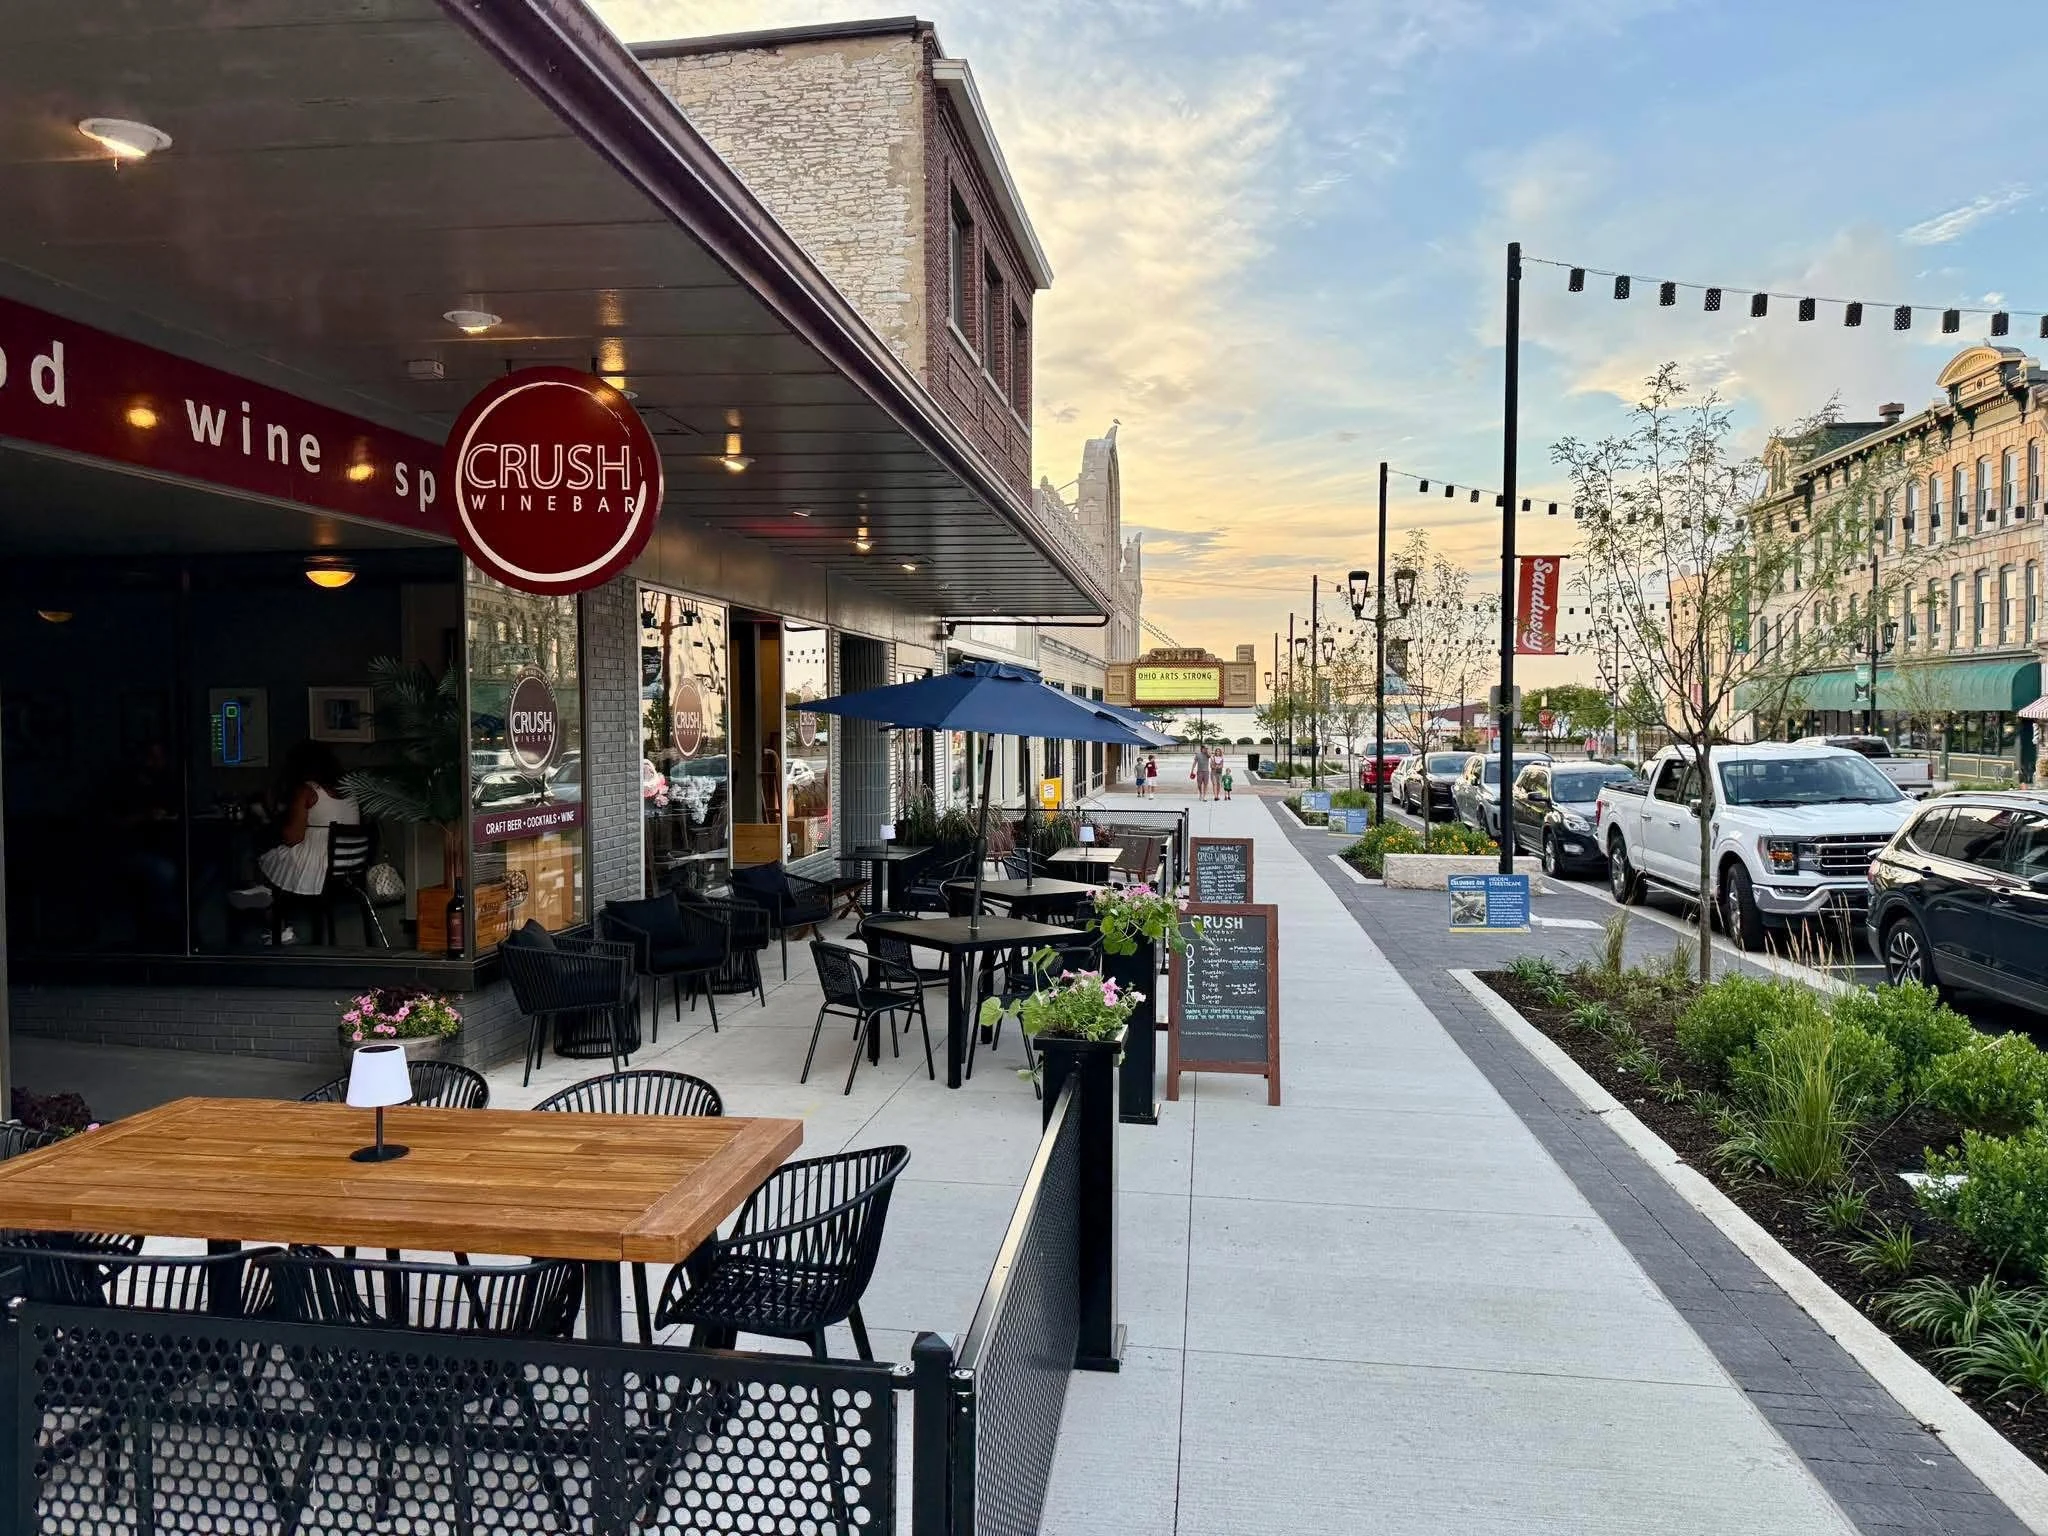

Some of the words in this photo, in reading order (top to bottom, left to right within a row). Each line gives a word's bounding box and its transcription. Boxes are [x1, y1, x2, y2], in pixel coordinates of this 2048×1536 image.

[0, 341, 65, 407] d
[185, 399, 321, 473] wine
[465, 443, 630, 490] CRUSH
[471, 494, 635, 513] WINEBAR
[1522, 558, 1554, 651] Sandusky
[1138, 672, 1157, 680] OHIO
[1160, 672, 1179, 680] ARTS
[1183, 672, 1212, 680] STRONG
[512, 711, 552, 734] CRUSH
[676, 711, 700, 729] CRUSH
[485, 821, 506, 835] CRAFT
[507, 818, 522, 831] BEER
[526, 813, 557, 828] COCKTAILS
[560, 810, 575, 823] WINE
[1185, 943, 1196, 1004] OPEN
